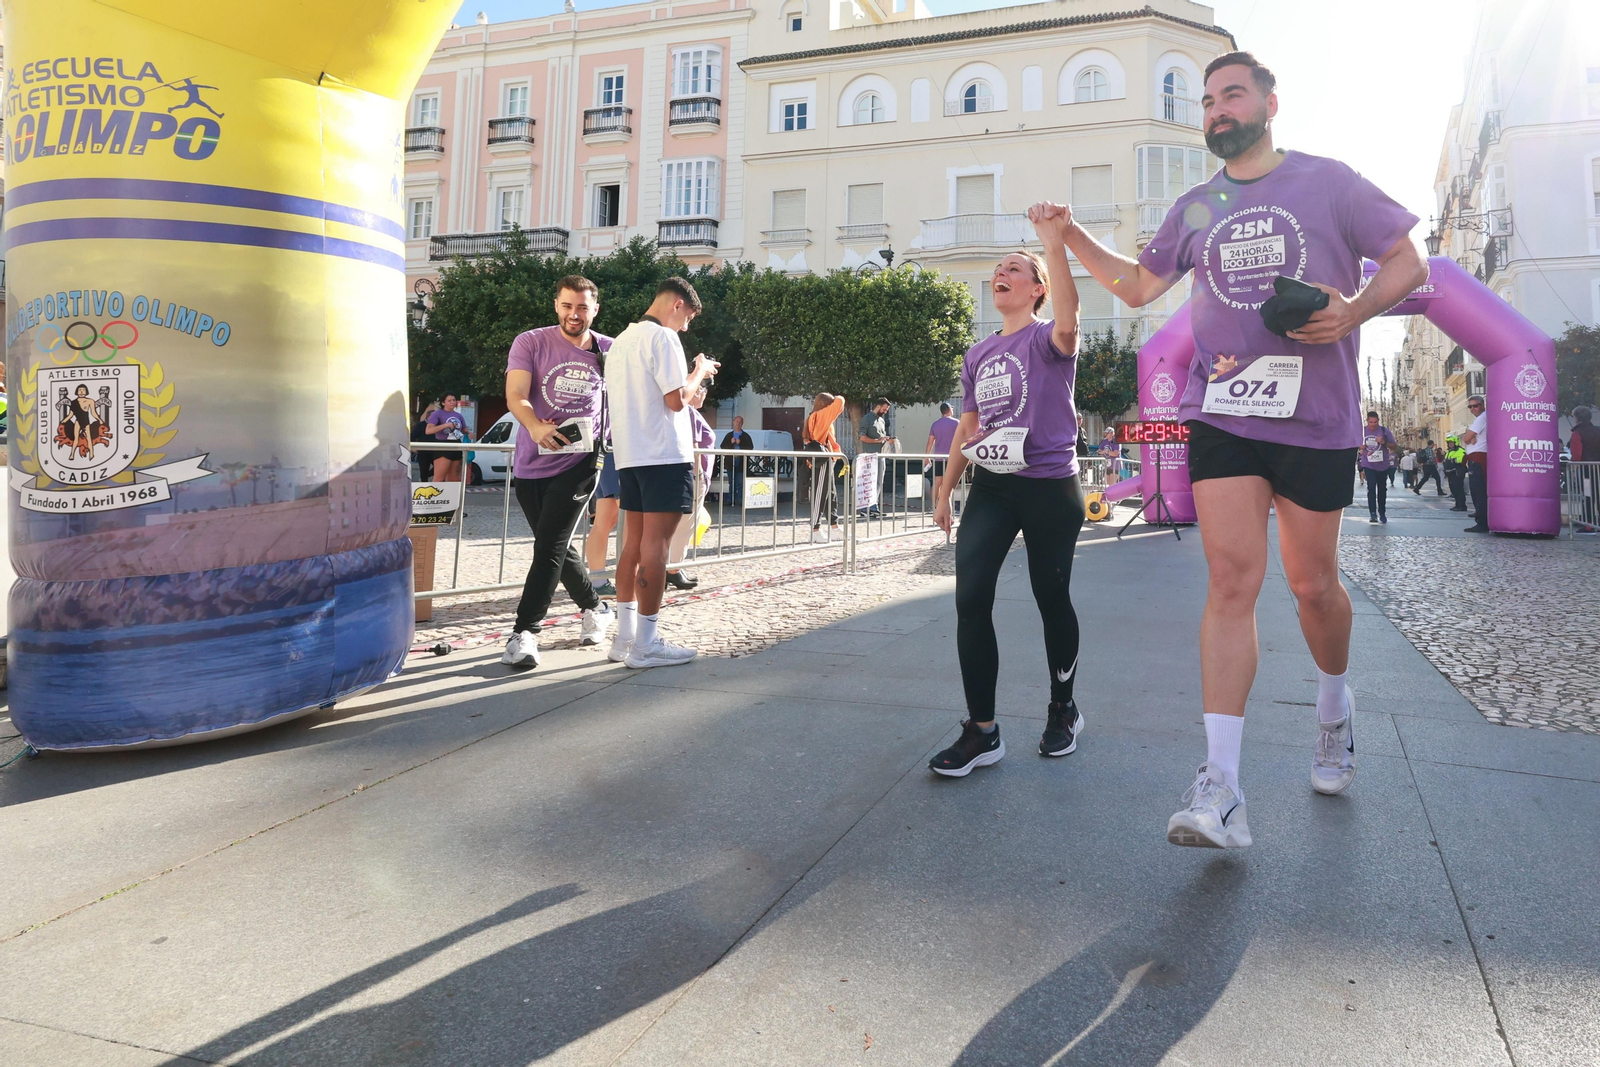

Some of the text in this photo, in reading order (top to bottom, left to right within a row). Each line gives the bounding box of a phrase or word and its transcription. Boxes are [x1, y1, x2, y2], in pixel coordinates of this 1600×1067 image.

[22, 57, 164, 85] ESCUELA
[6, 84, 146, 119] ATLETISMO
[14, 108, 221, 163] OLIMPO
[1205, 205, 1268, 248] INTERNACIONAL
[1269, 205, 1301, 232] CONTRA
[1297, 231, 1306, 246] LA
[1230, 217, 1274, 240] 25N
[1230, 244, 1274, 258] 24 HORAS
[1224, 254, 1281, 269] 900 21 21 30
[1206, 269, 1231, 305] MUJERES
[1231, 300, 1249, 310] LAS
[131, 295, 231, 347] OLIMPO
[1003, 351, 1024, 371] CONTRA
[48, 368, 121, 379] ATLETISMO
[564, 368, 591, 380] 25N
[984, 381, 1004, 391] HORAS
[1229, 379, 1278, 399] 074
[1013, 380, 1028, 418] VIOLENCIA
[1214, 397, 1241, 406] ROMPE
[1500, 400, 1556, 412] Ayuntamiento
[40, 390, 48, 444] CLUB DE
[123, 390, 135, 434] OLIMPO
[1143, 405, 1178, 417] Ayuntamie
[1511, 411, 1551, 422] de Cádiz
[1508, 436, 1554, 451] fmm
[976, 444, 1009, 460] 032
[1509, 448, 1554, 463] CÁDIZ
[58, 468, 108, 483] CADIZ
[27, 486, 157, 509] Fundado 1 Abril 1968
